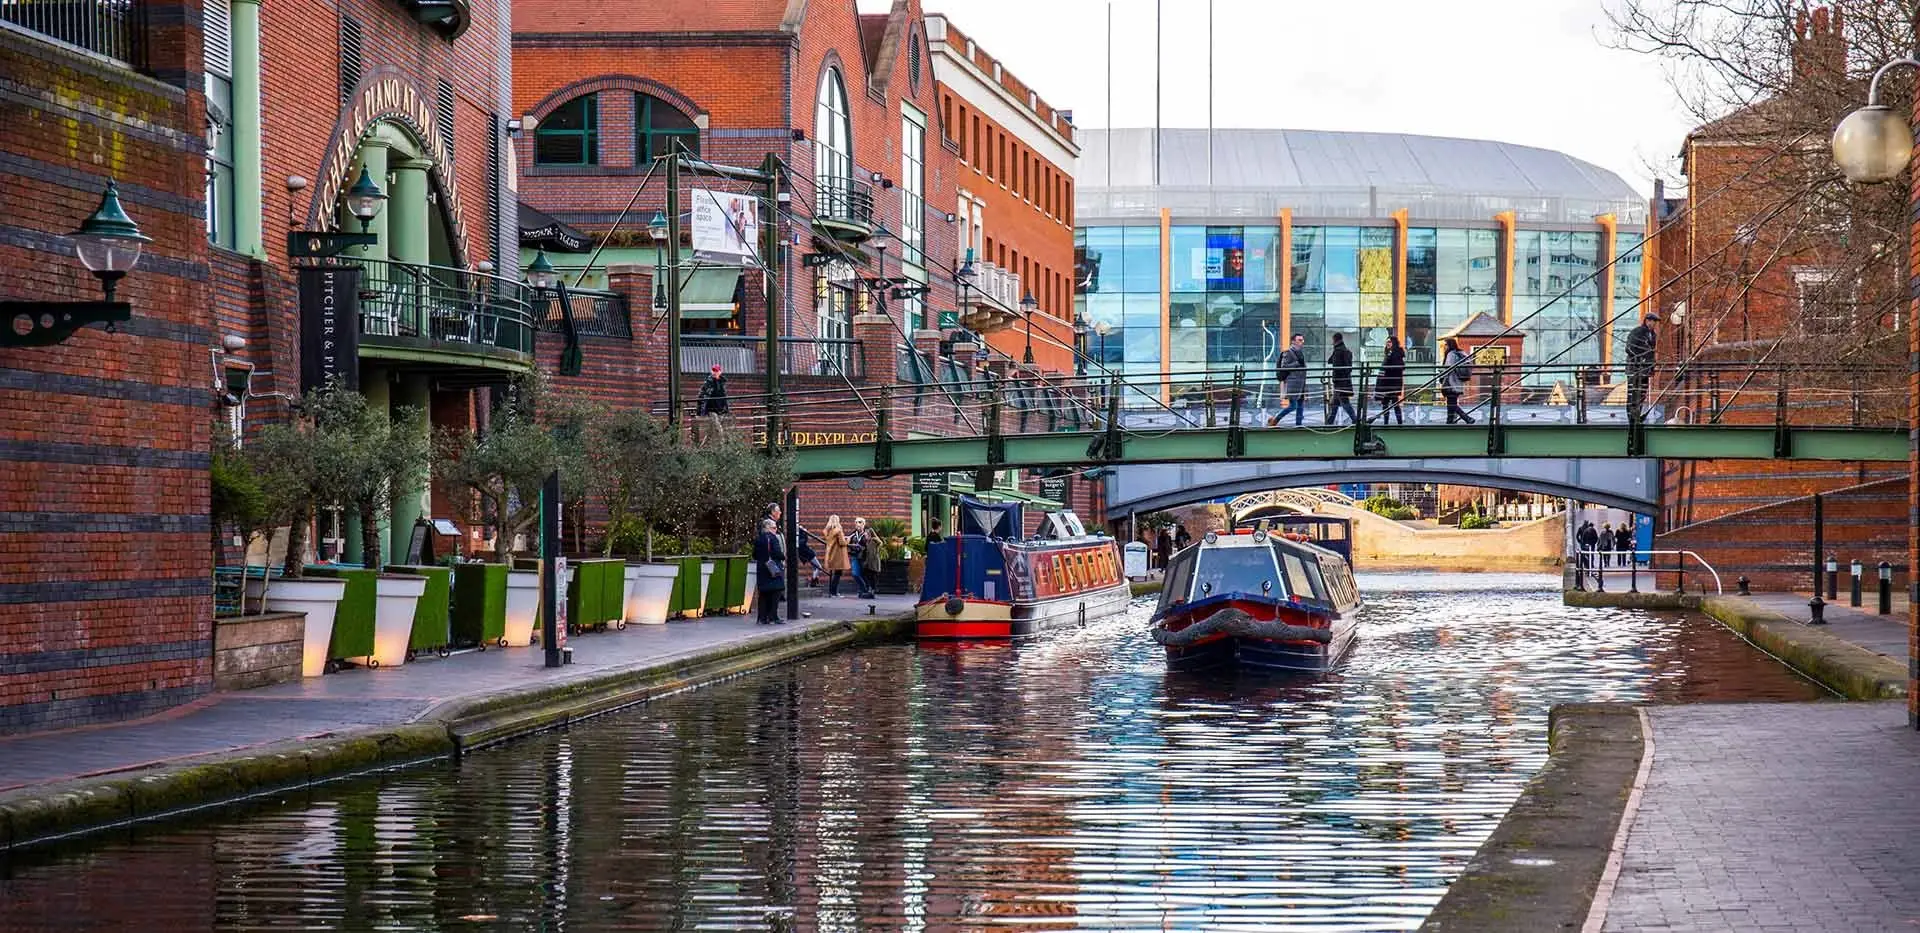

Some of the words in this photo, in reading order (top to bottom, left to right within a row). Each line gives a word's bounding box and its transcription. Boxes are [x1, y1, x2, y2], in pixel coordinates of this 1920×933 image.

[353, 105, 363, 137] &
[365, 78, 400, 120] PIANO
[402, 83, 416, 117] AT
[323, 272, 334, 335] PITCHER
[323, 340, 334, 350] &
